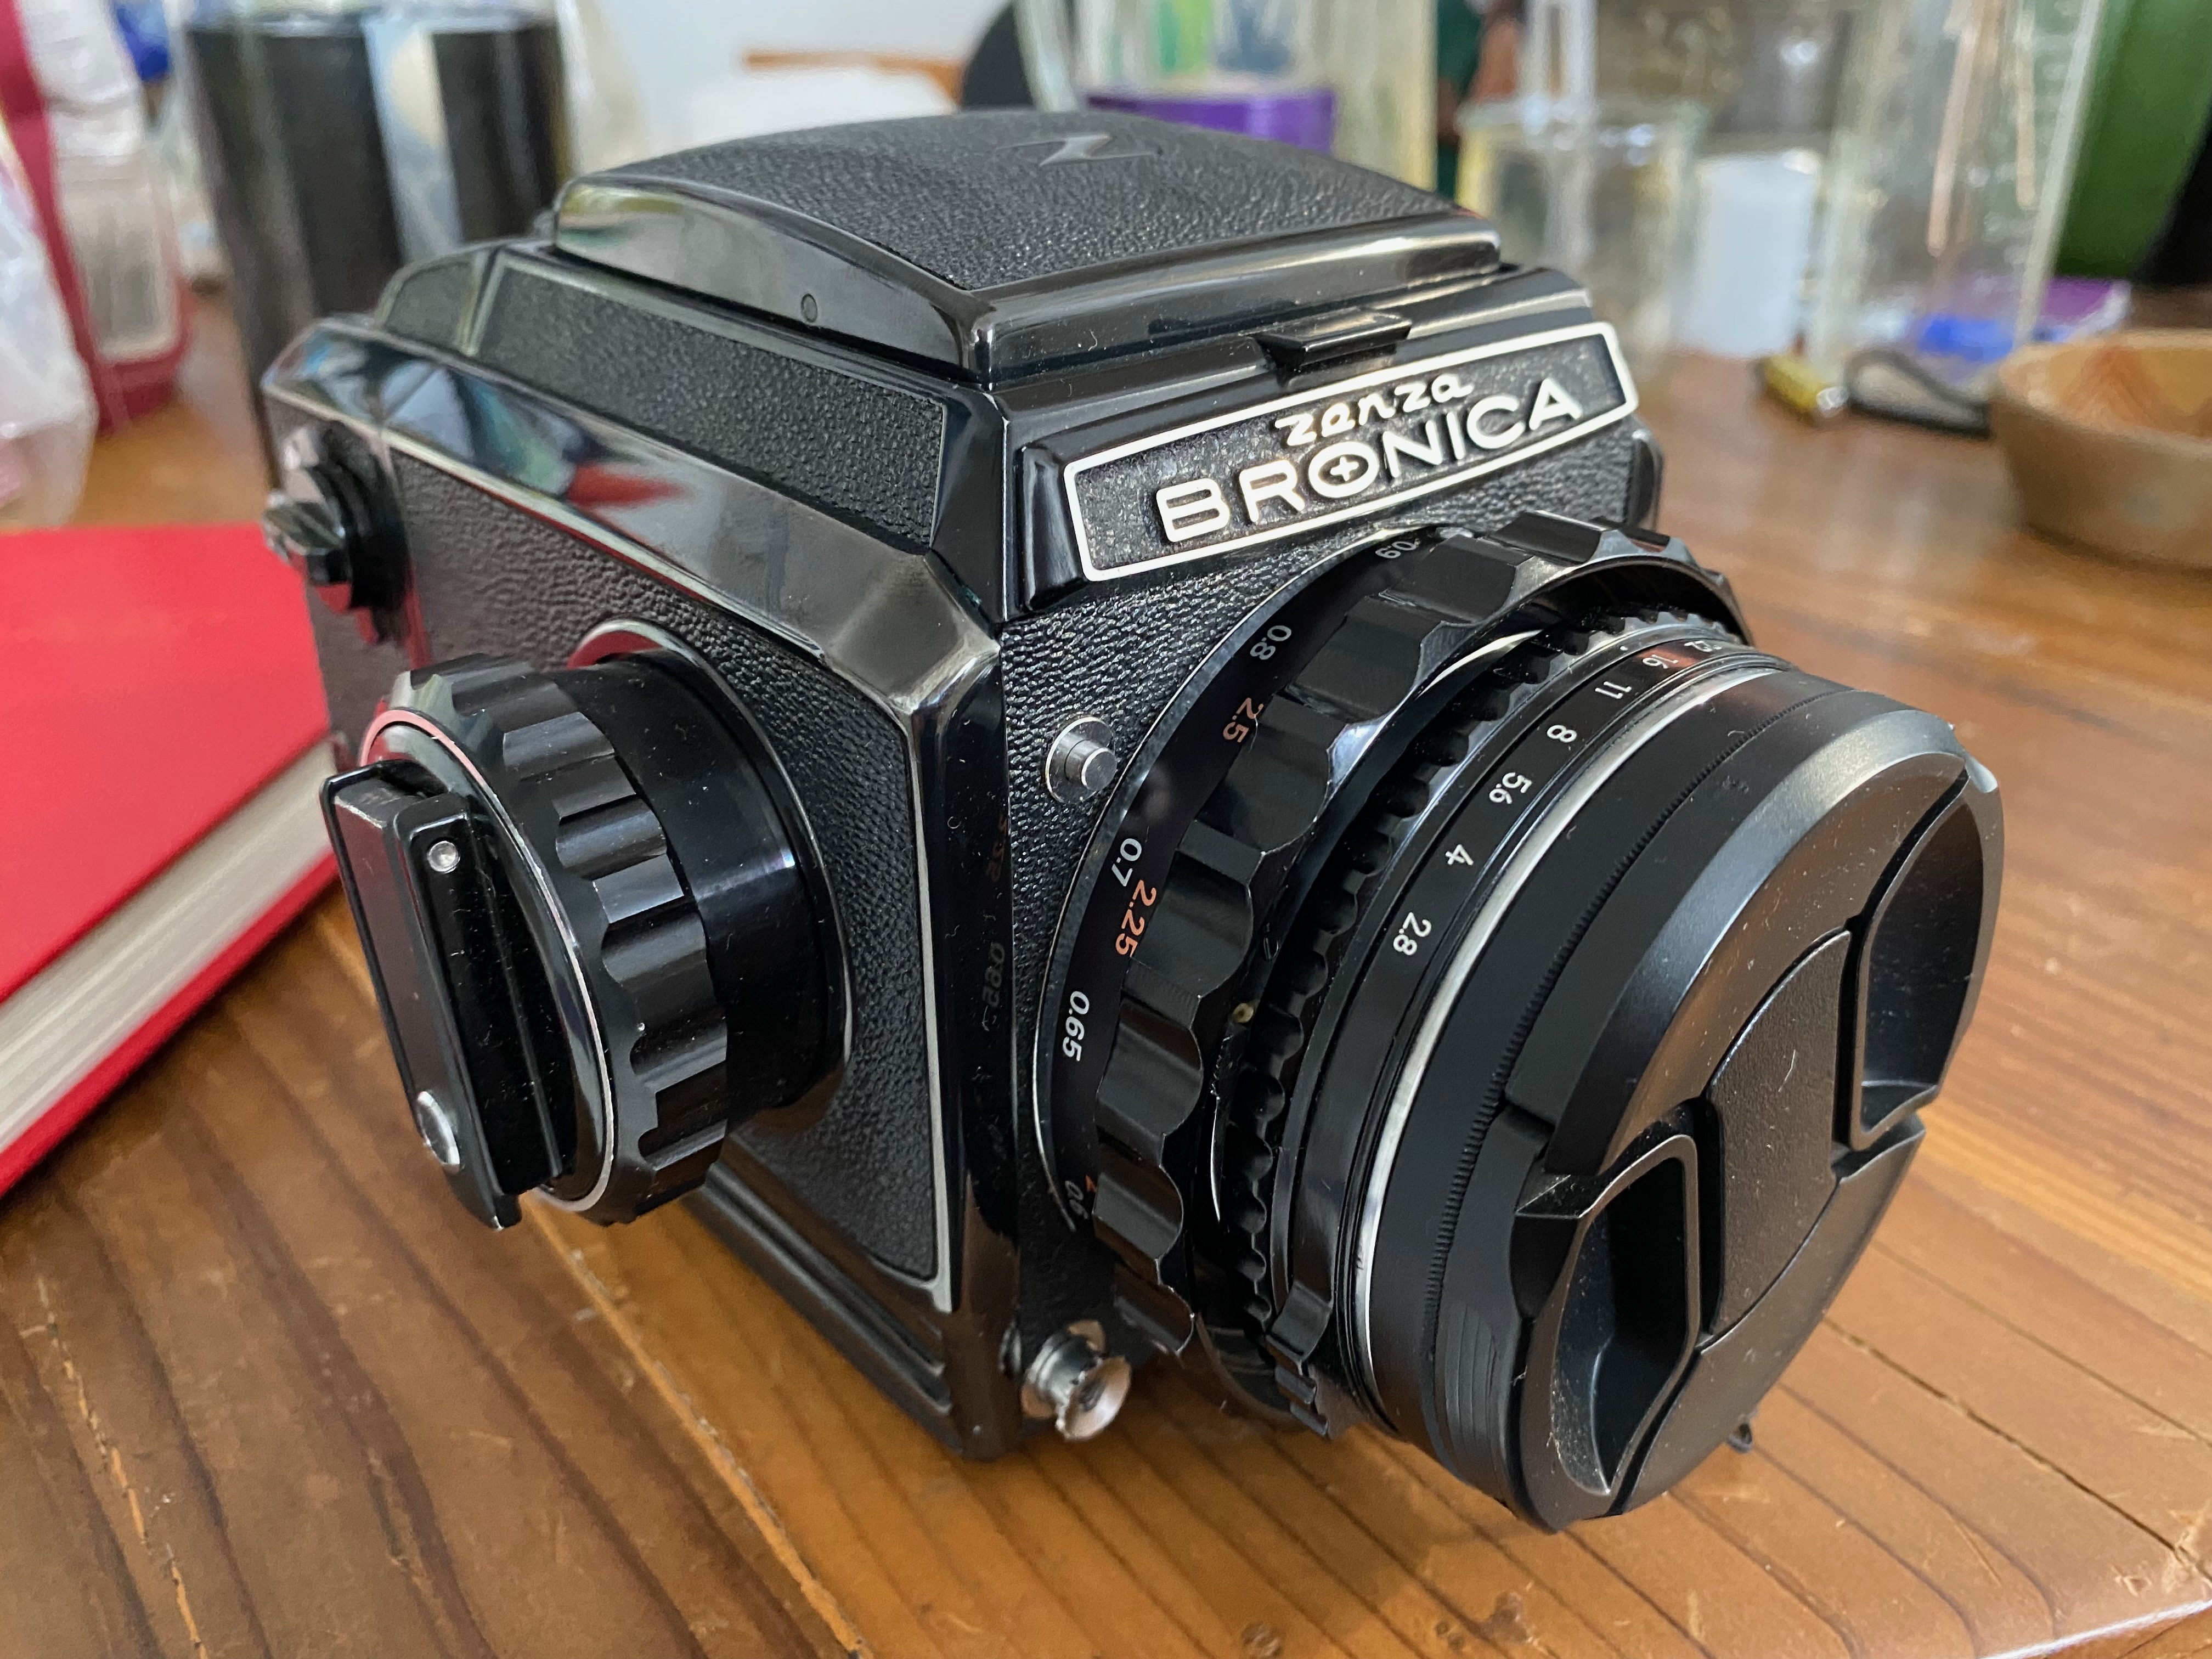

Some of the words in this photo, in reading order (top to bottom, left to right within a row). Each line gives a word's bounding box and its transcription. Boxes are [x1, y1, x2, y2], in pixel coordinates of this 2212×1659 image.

[1156, 378, 1582, 542] BRONICA
[1250, 625, 1292, 660] 0.8
[1643, 654, 1679, 669] 16
[1595, 681, 1632, 699] 11
[1222, 698, 1263, 743] 2.5
[1547, 725, 1577, 743] 8
[1489, 772, 1532, 805] 5.6
[1111, 838, 1142, 887] 0.7
[1445, 844, 1474, 866] 4
[1115, 879, 1157, 956] 2.25
[1393, 912, 1431, 956] 2.8
[1063, 990, 1090, 1062] 0.65
